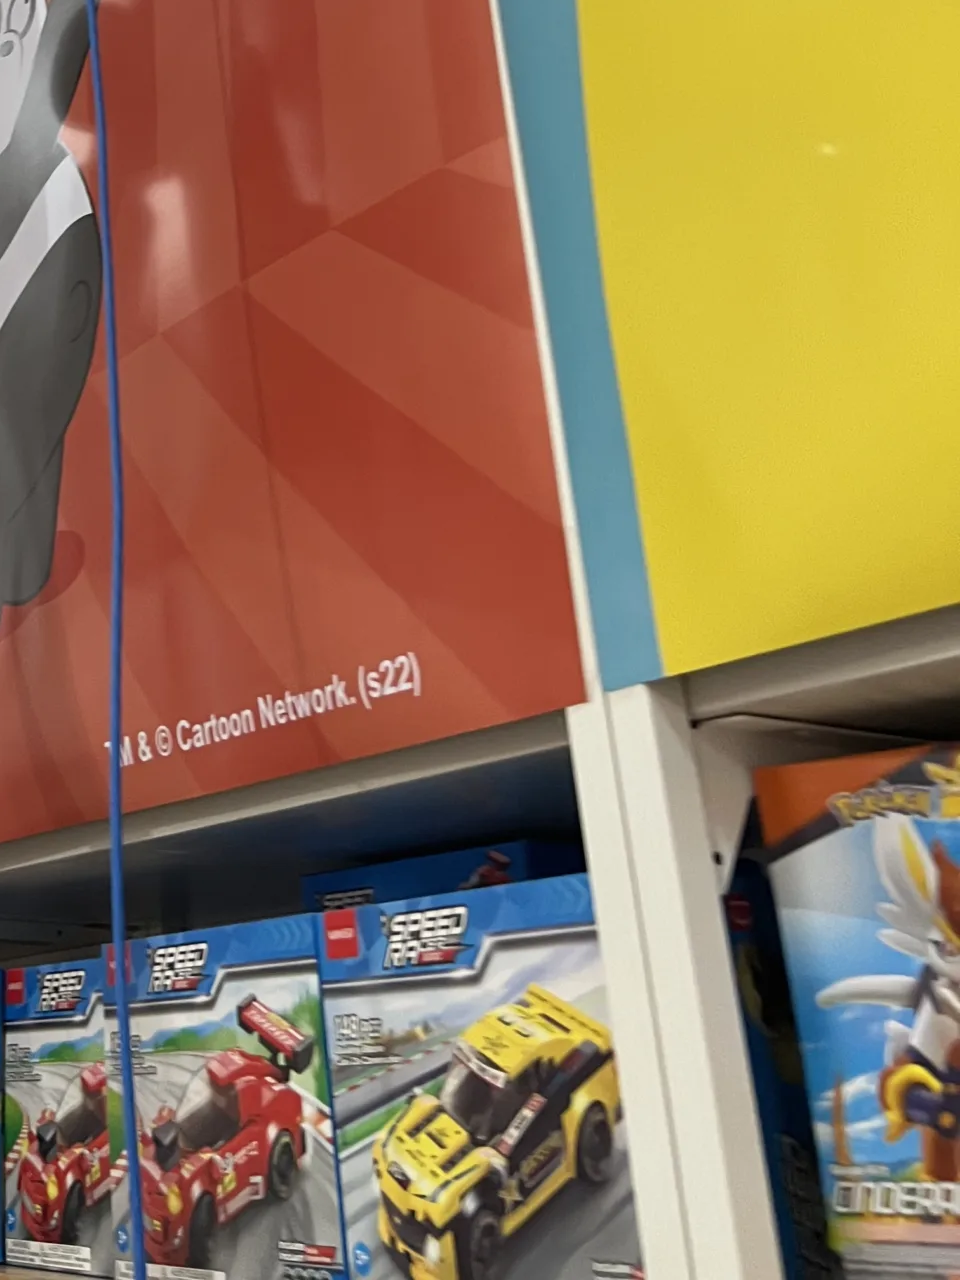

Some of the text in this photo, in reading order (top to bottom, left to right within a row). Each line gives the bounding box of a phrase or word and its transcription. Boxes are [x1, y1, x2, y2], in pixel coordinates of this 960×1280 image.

[138, 730, 153, 762] &
[176, 708, 256, 752] Cartoon
[257, 674, 357, 729] Network.
[357, 651, 422, 710] (s22)
[389, 906, 468, 942] SPEED
[151, 942, 208, 972] SPEED
[42, 970, 86, 994] SPEED
